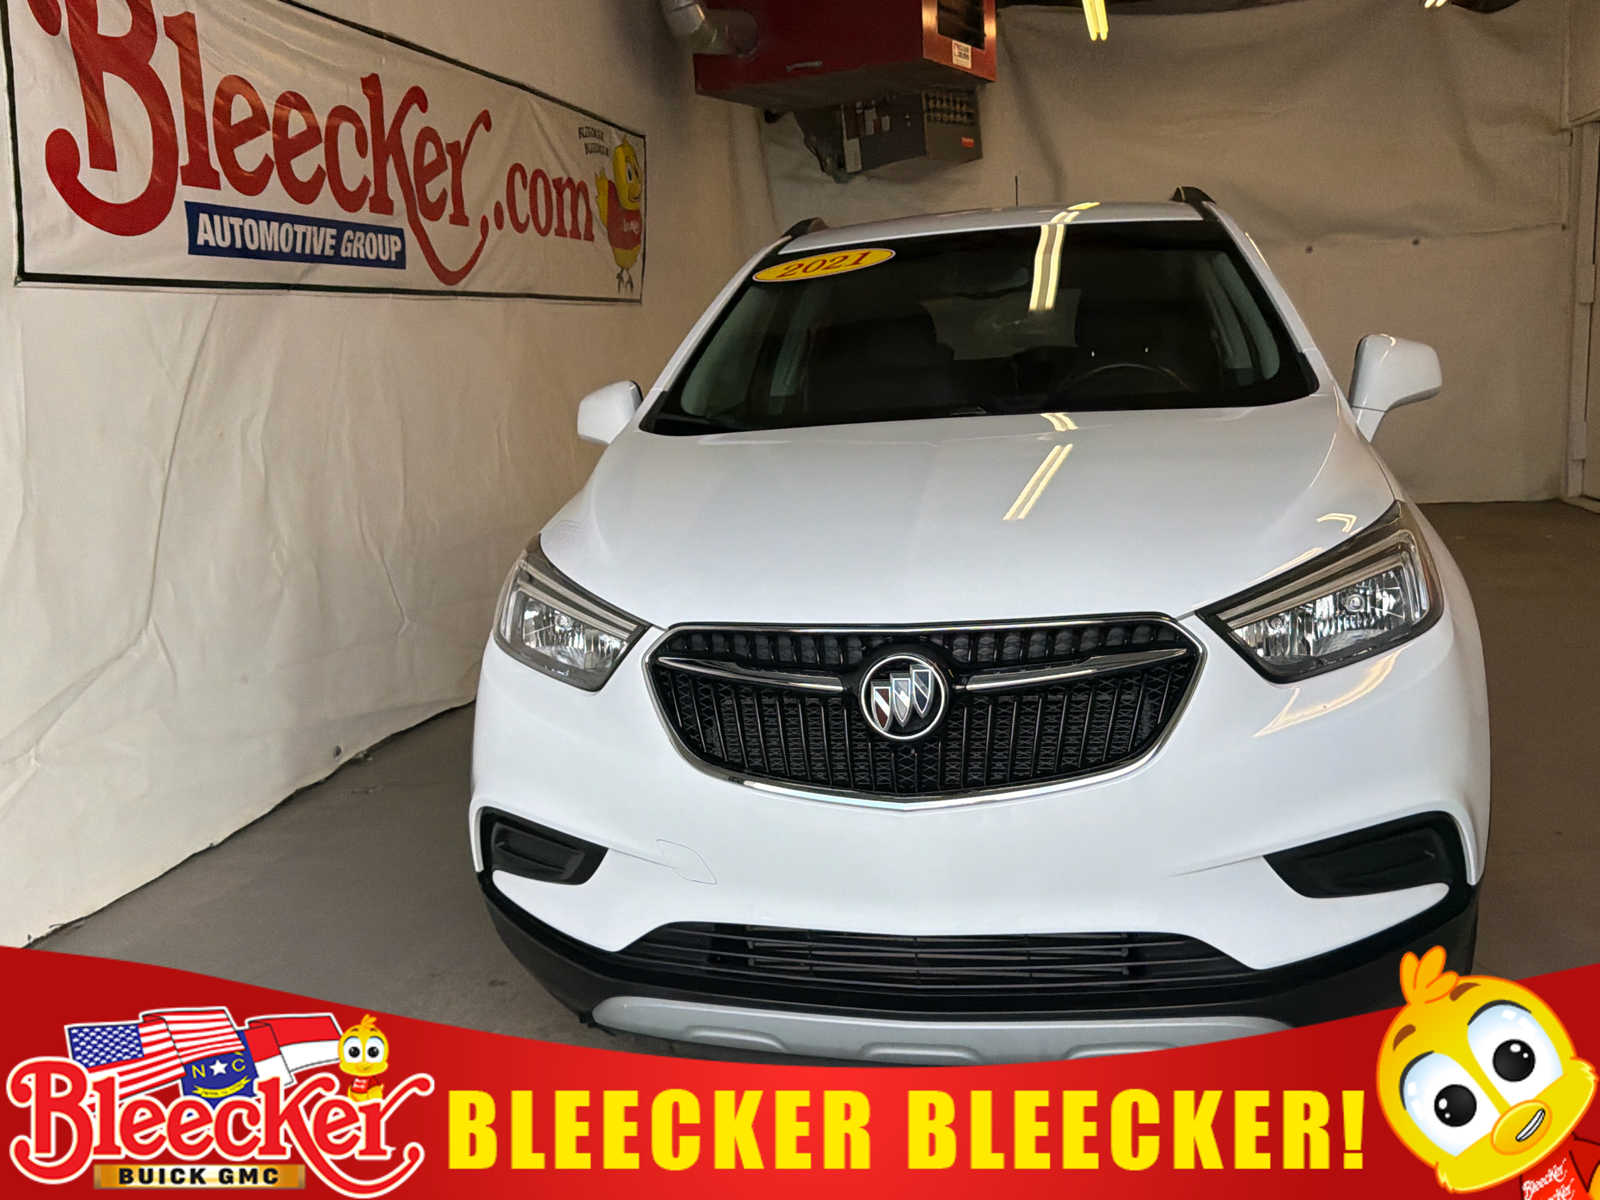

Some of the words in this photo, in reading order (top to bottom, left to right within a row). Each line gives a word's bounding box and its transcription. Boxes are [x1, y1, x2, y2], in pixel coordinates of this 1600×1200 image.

[197, 211, 335, 257] AUTOMOTIVE
[341, 230, 402, 262] GROUP
[776, 250, 872, 279] 2021
